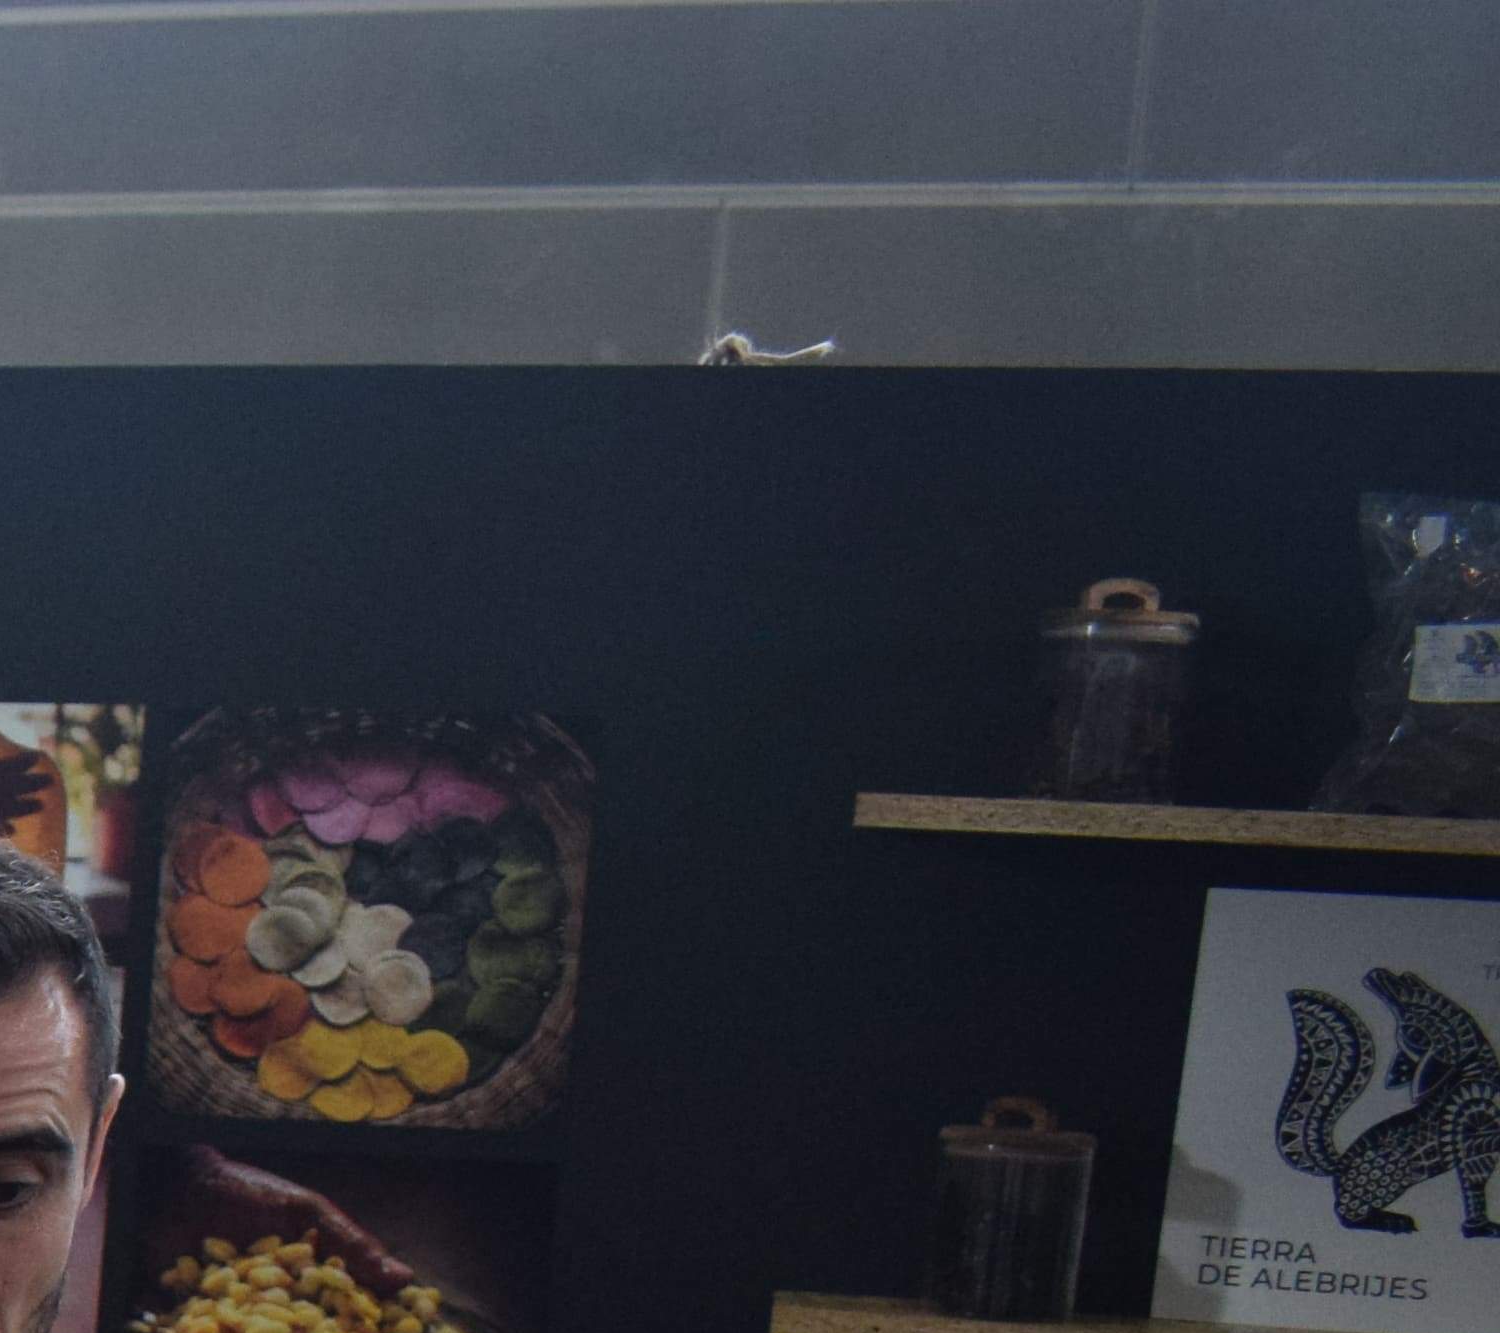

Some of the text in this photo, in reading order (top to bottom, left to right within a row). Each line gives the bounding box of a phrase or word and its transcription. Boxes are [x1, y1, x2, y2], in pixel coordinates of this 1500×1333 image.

[1201, 1235, 1316, 1264] TIERRA
[1197, 1263, 1428, 1300] DE ALEBRIJES
